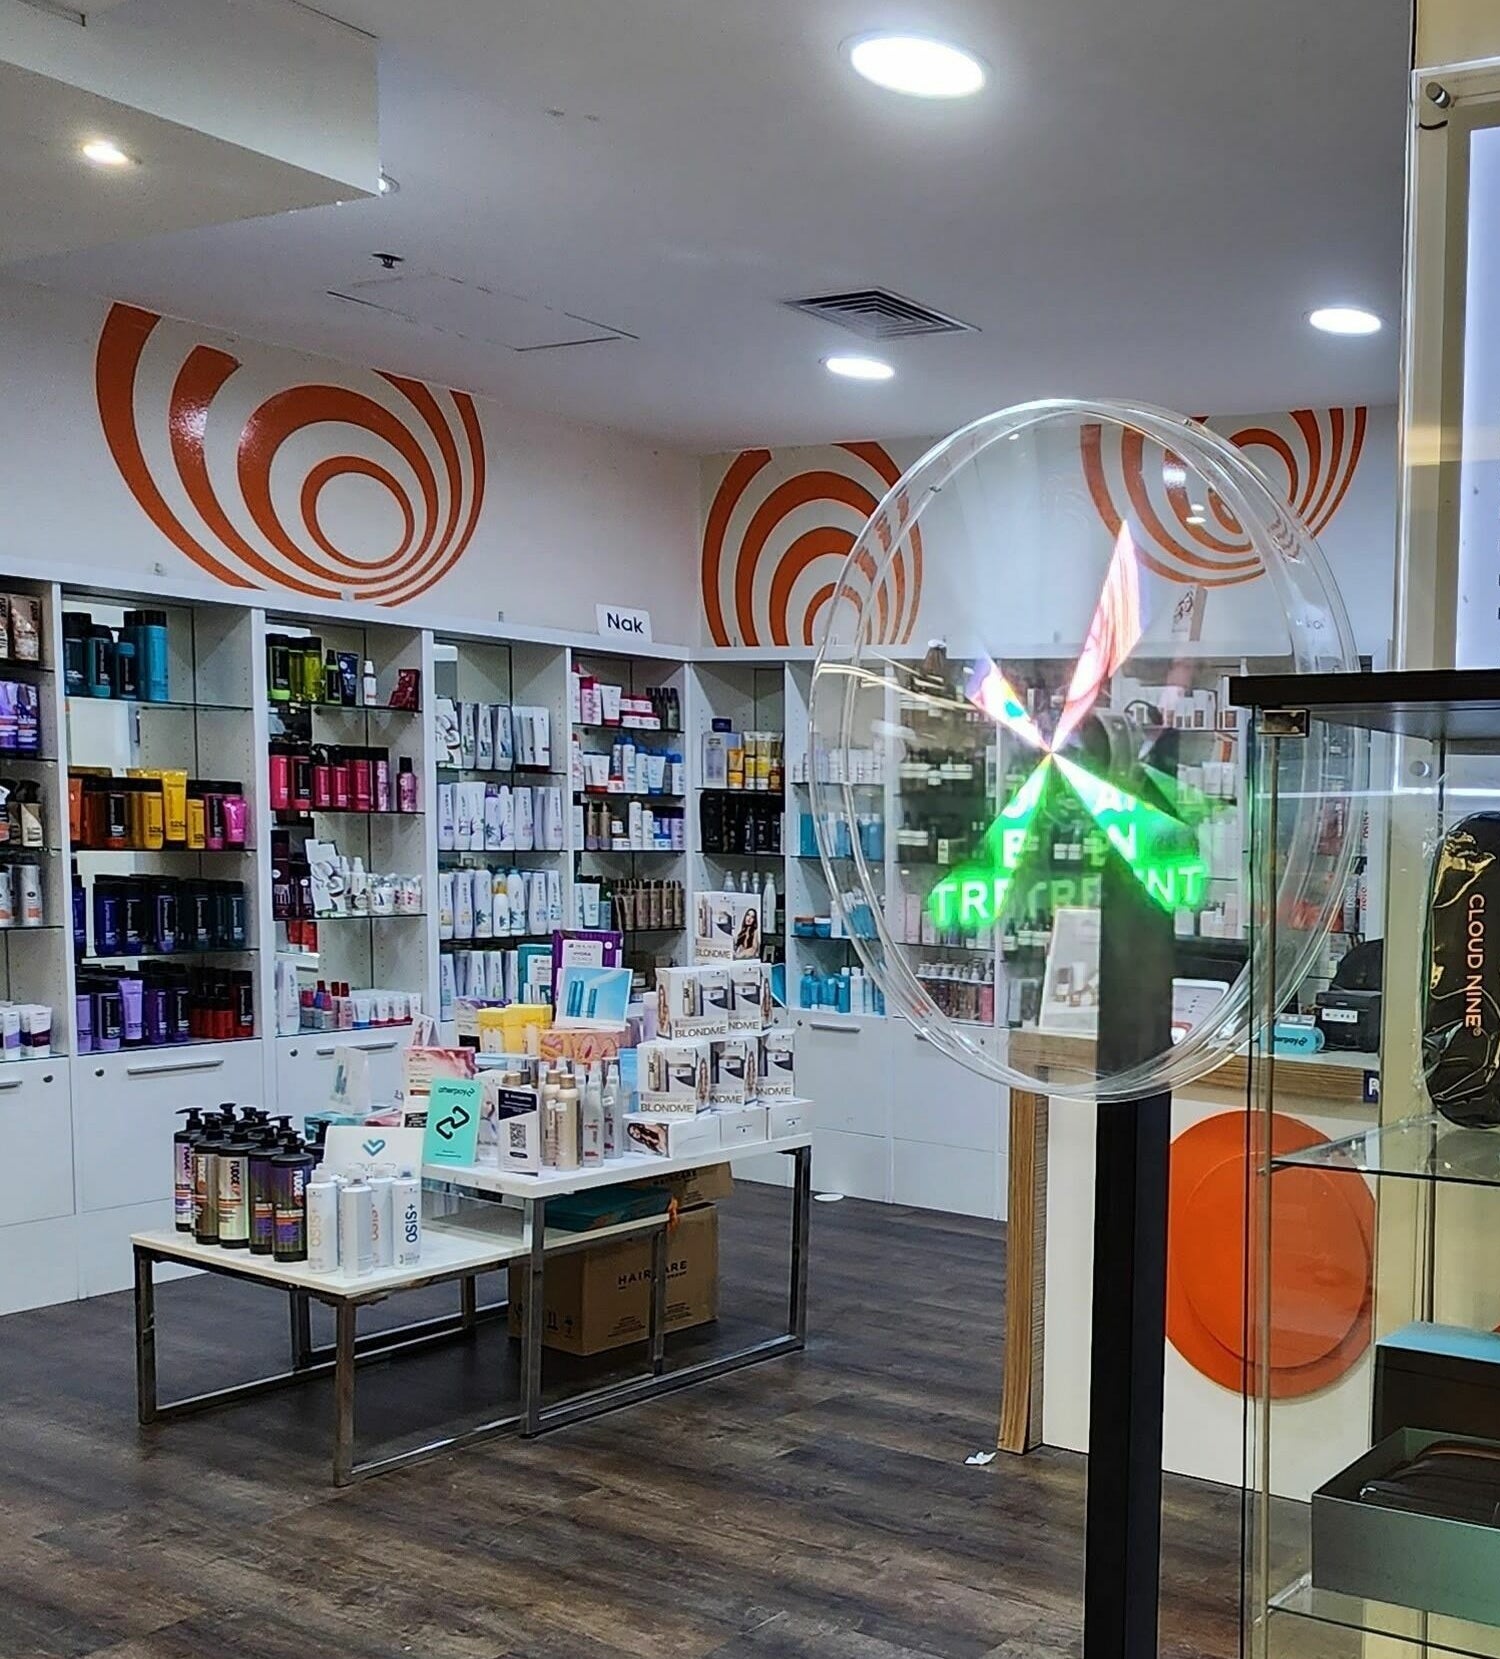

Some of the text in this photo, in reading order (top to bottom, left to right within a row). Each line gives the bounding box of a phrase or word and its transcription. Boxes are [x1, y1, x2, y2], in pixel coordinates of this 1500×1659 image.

[607, 612, 644, 634] Nak
[1465, 894, 1484, 1028] CLOUD NINE
[728, 1021, 759, 1030] NDME
[675, 1026, 727, 1038] BLONDME
[755, 1087, 791, 1096] NDME
[711, 1095, 742, 1104] NDME
[641, 1103, 694, 1113] BLONDME
[618, 1260, 688, 1285] HAIRARE
